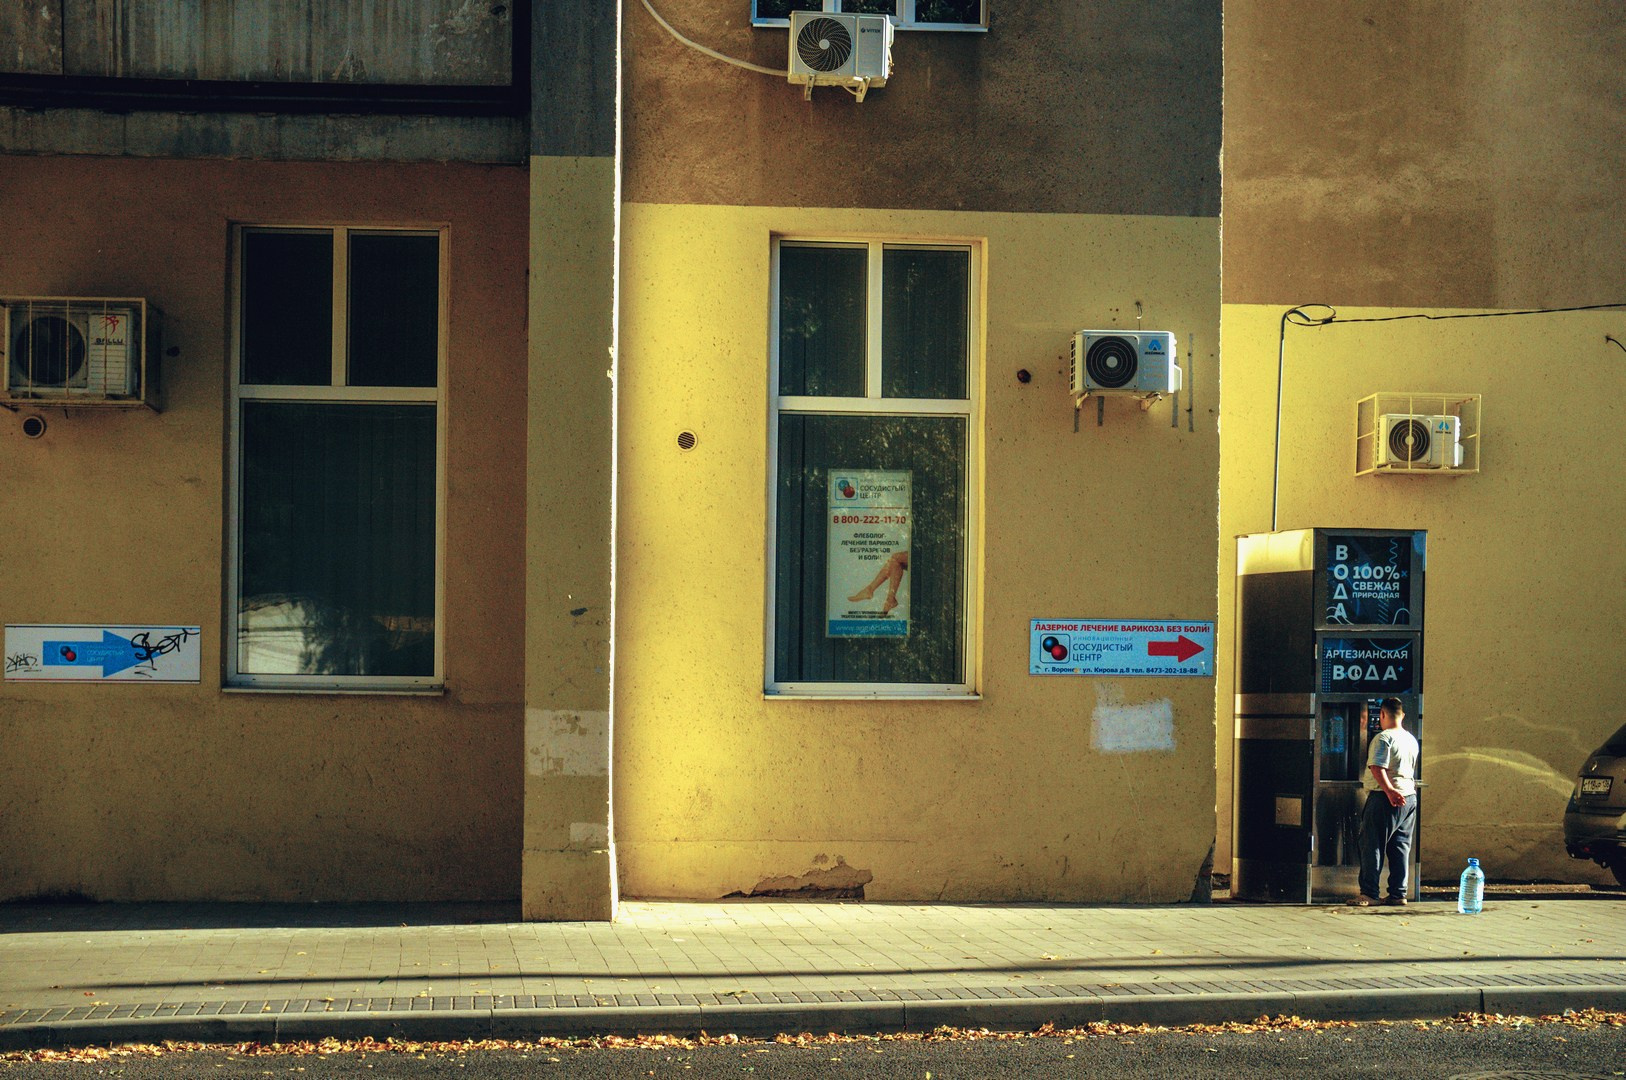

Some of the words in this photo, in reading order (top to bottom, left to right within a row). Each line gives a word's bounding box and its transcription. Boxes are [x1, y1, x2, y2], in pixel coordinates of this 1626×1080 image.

[833, 515, 839, 524] 8
[841, 515, 907, 524] 800-222-11-70
[1352, 564, 1400, 580] 100%
[1352, 581, 1400, 591] СВЕЖАЯ
[1352, 591, 1400, 600] ПРИРОДНАЯ
[1080, 624, 1119, 632] ЛЕЧЕНИЕ
[1183, 625, 1210, 633] БОЛИ!
[1072, 643, 1133, 653] СОСУДИСТЫЙ
[1072, 653, 1102, 662] ЦЕНТР
[1325, 649, 1408, 659] АРТЕЗИАНСКАЯ
[1094, 666, 1118, 674] Кирова
[1332, 664, 1398, 681] ВОДА
